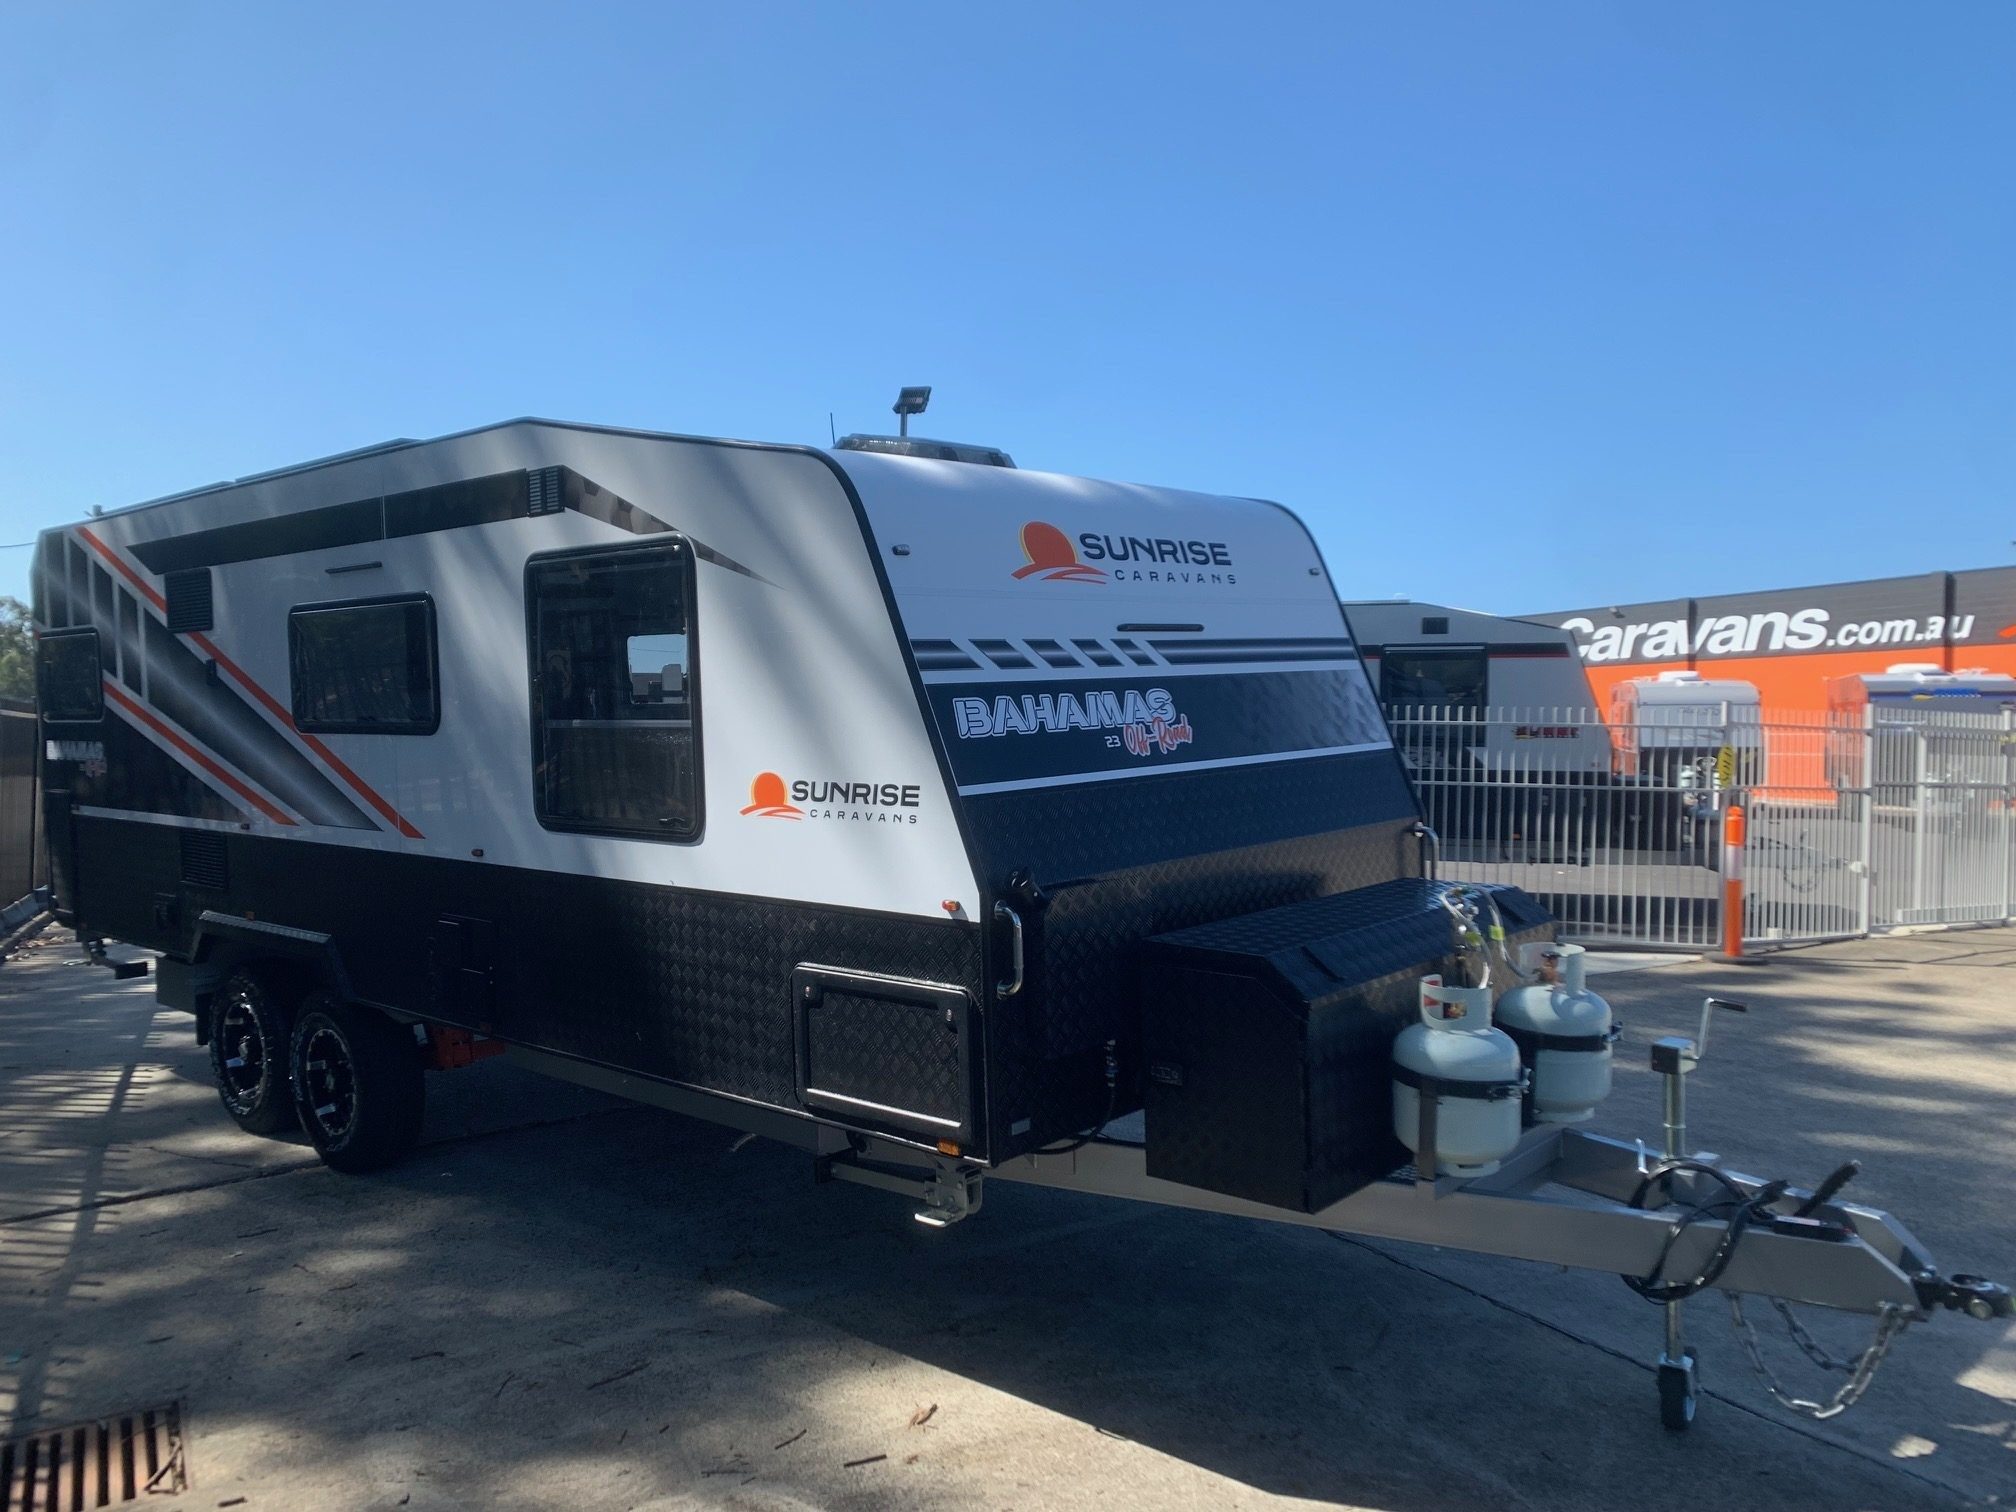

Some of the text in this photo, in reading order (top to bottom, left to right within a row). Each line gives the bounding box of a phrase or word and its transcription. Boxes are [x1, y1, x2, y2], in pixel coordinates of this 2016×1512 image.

[1079, 532, 1233, 566] SUNRISE
[1114, 569, 1237, 585] CARAVANS
[953, 688, 1177, 739] BAHAMAS
[1104, 735, 1121, 749] 23
[791, 780, 921, 807] SUNRISE
[809, 809, 918, 825] CARAVANS
